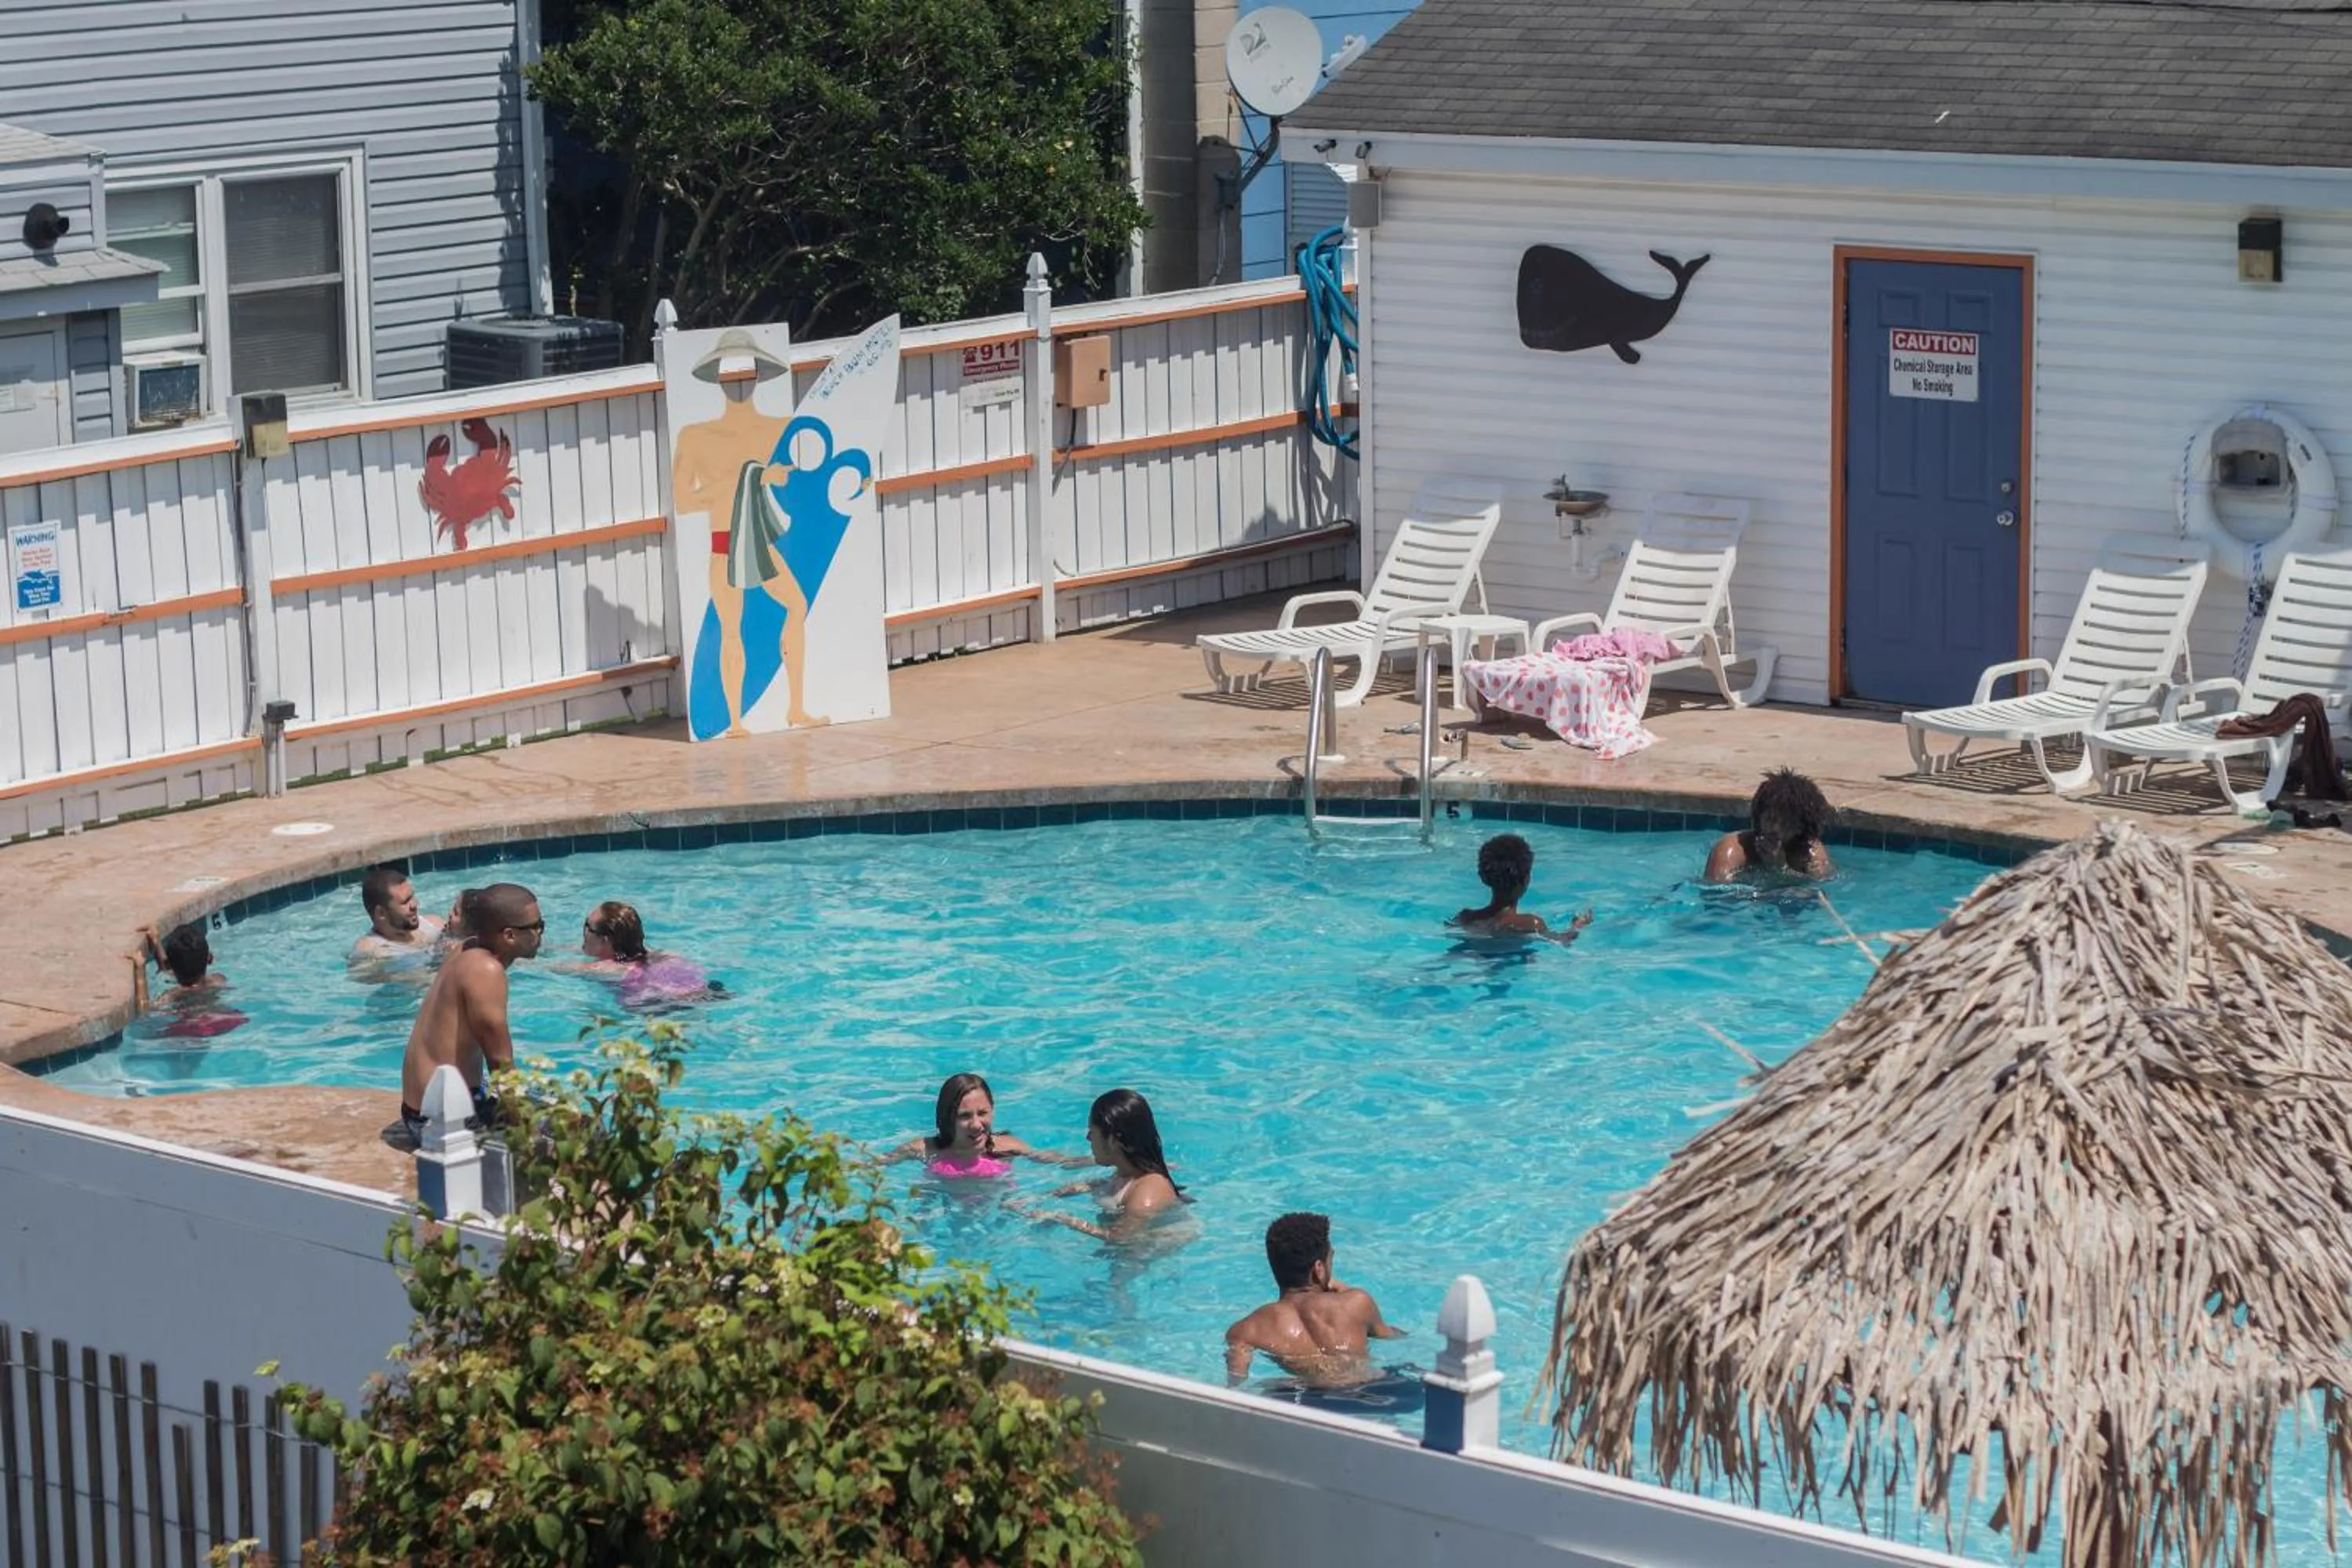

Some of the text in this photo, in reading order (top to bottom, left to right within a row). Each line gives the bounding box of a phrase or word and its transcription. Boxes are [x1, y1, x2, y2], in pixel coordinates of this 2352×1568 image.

[980, 339, 1019, 361] 911
[1895, 333, 1975, 354] CAUTION
[1893, 358, 1973, 377] Chemical Storage Area
[1912, 378, 1954, 397] No Smoking
[15, 531, 55, 547] WARNING
[1446, 801, 1460, 818] 5
